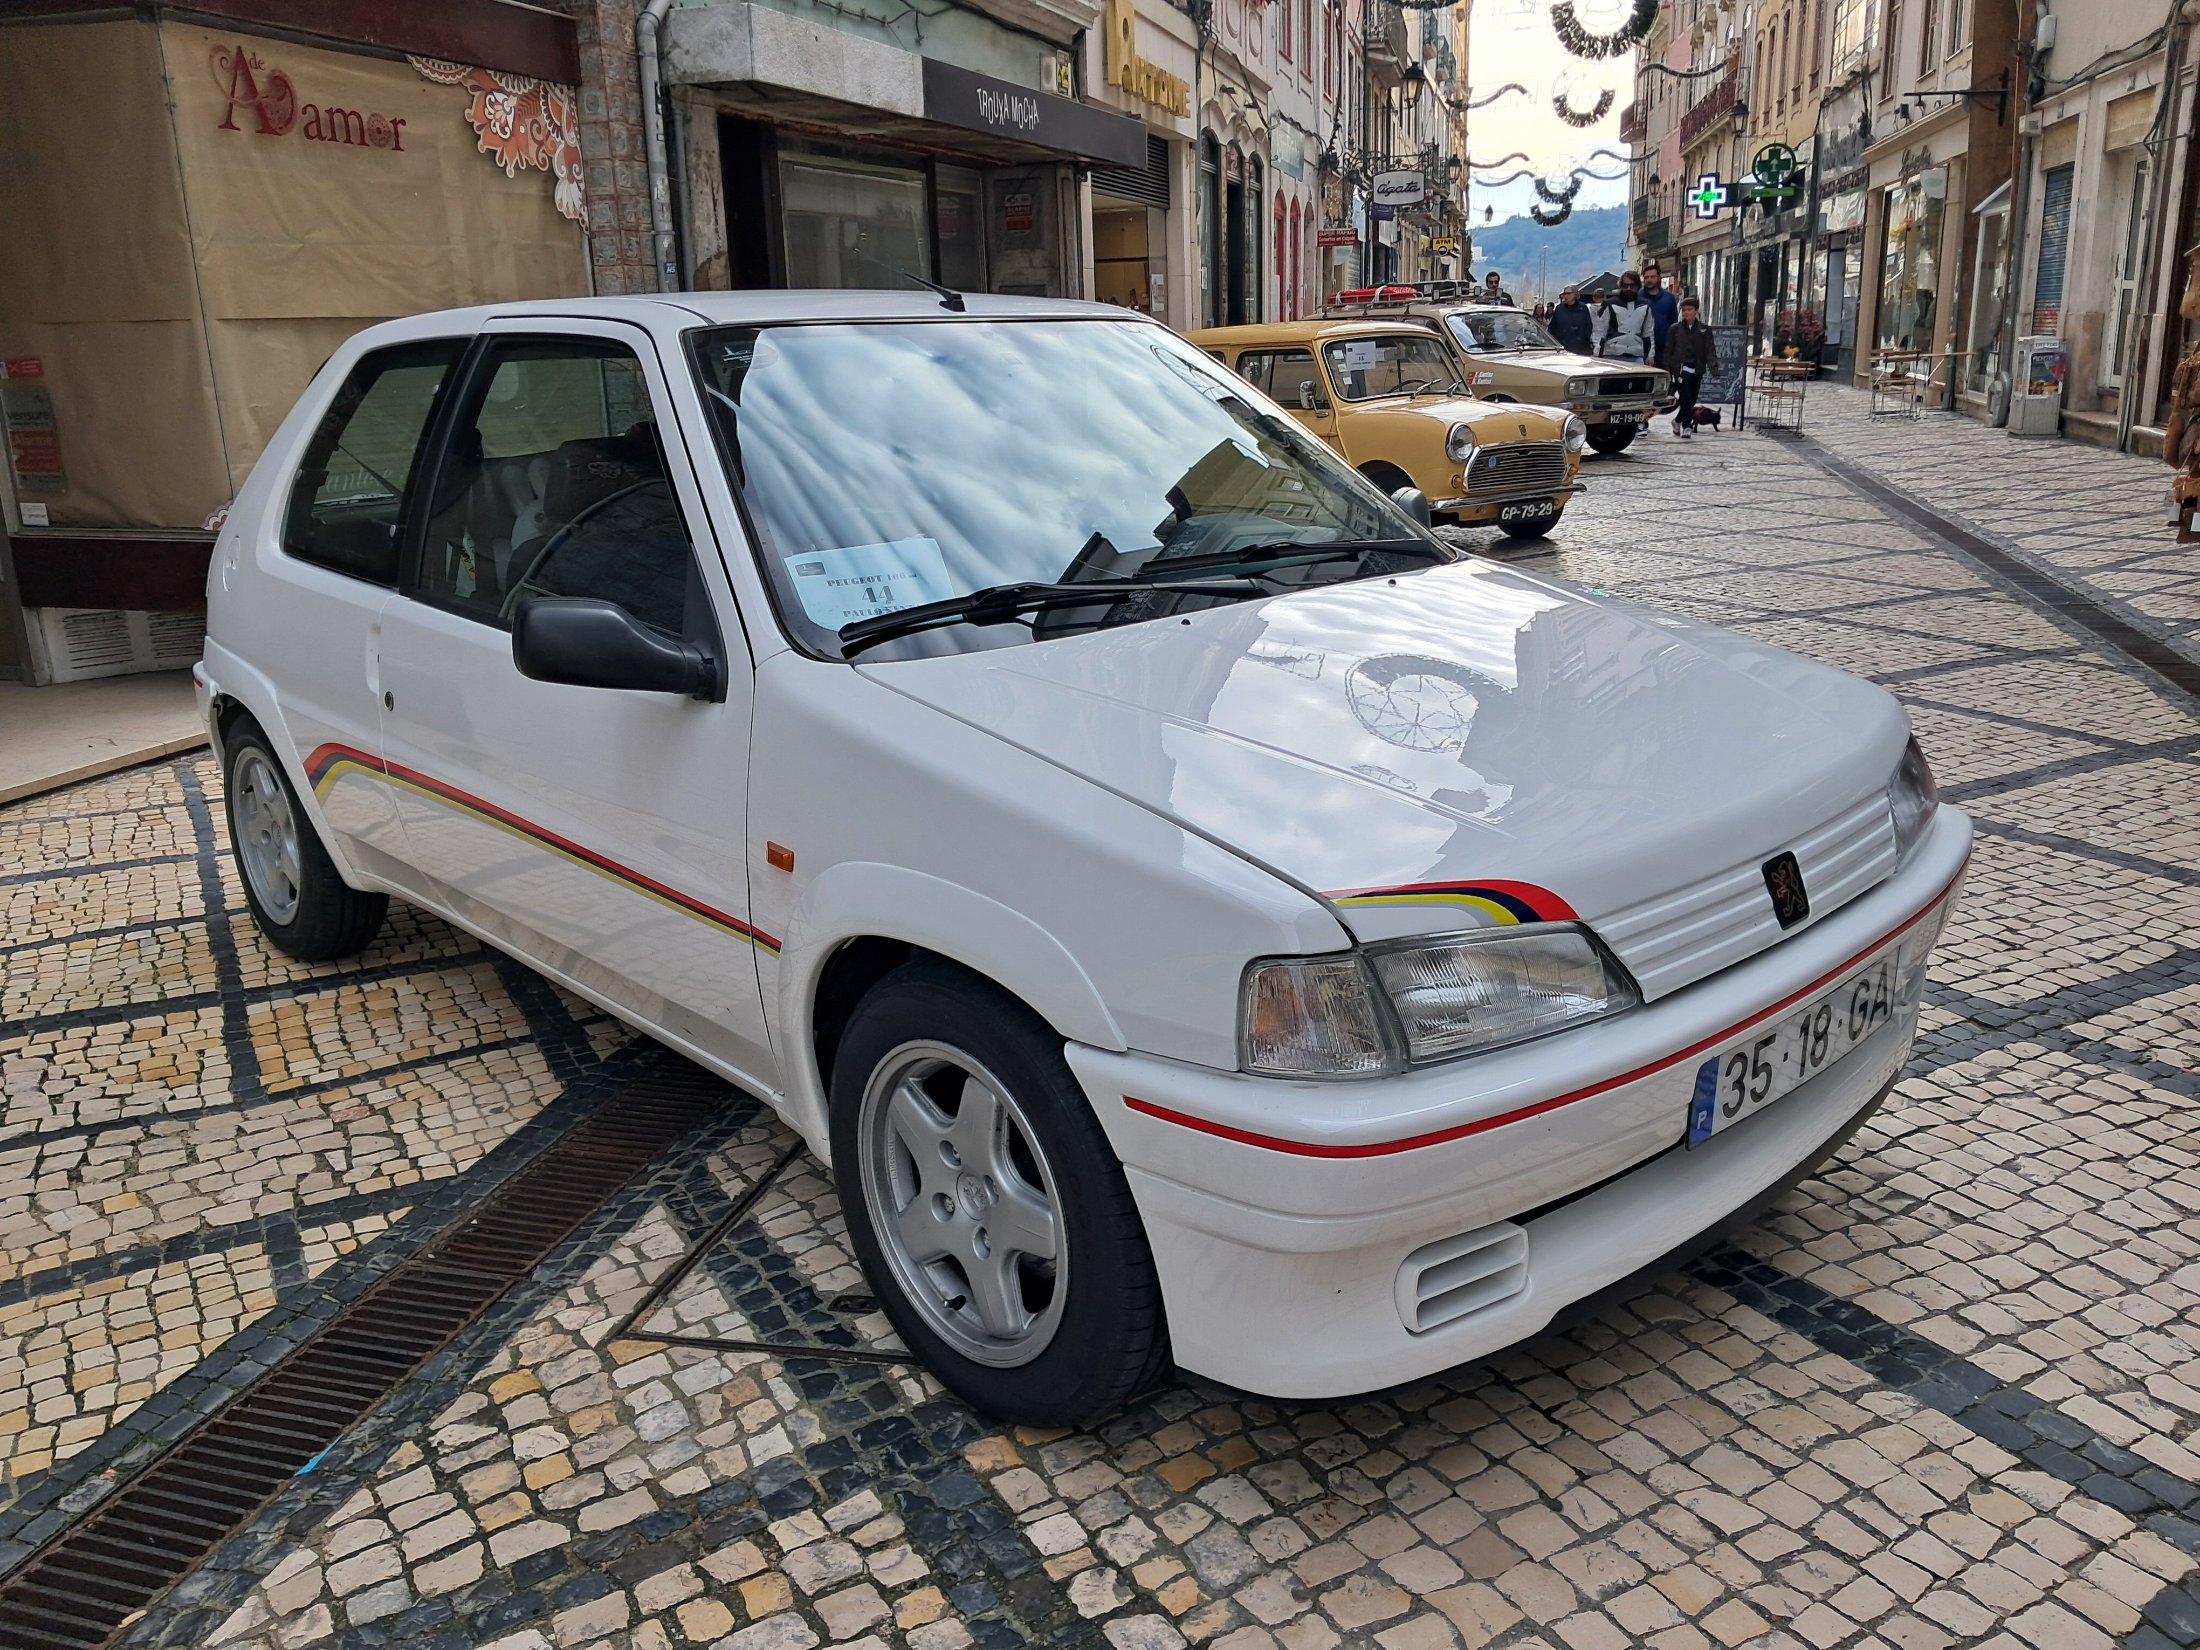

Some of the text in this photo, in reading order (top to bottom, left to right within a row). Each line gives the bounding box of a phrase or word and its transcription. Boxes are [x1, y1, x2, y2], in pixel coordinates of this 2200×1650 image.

[976, 88, 1039, 130] TROUXA MOCHA
[1501, 502, 1553, 520] GP-79-29
[826, 574, 883, 587] PEUGEOT
[862, 585, 895, 603] 44
[1697, 1109, 1708, 1130] P
